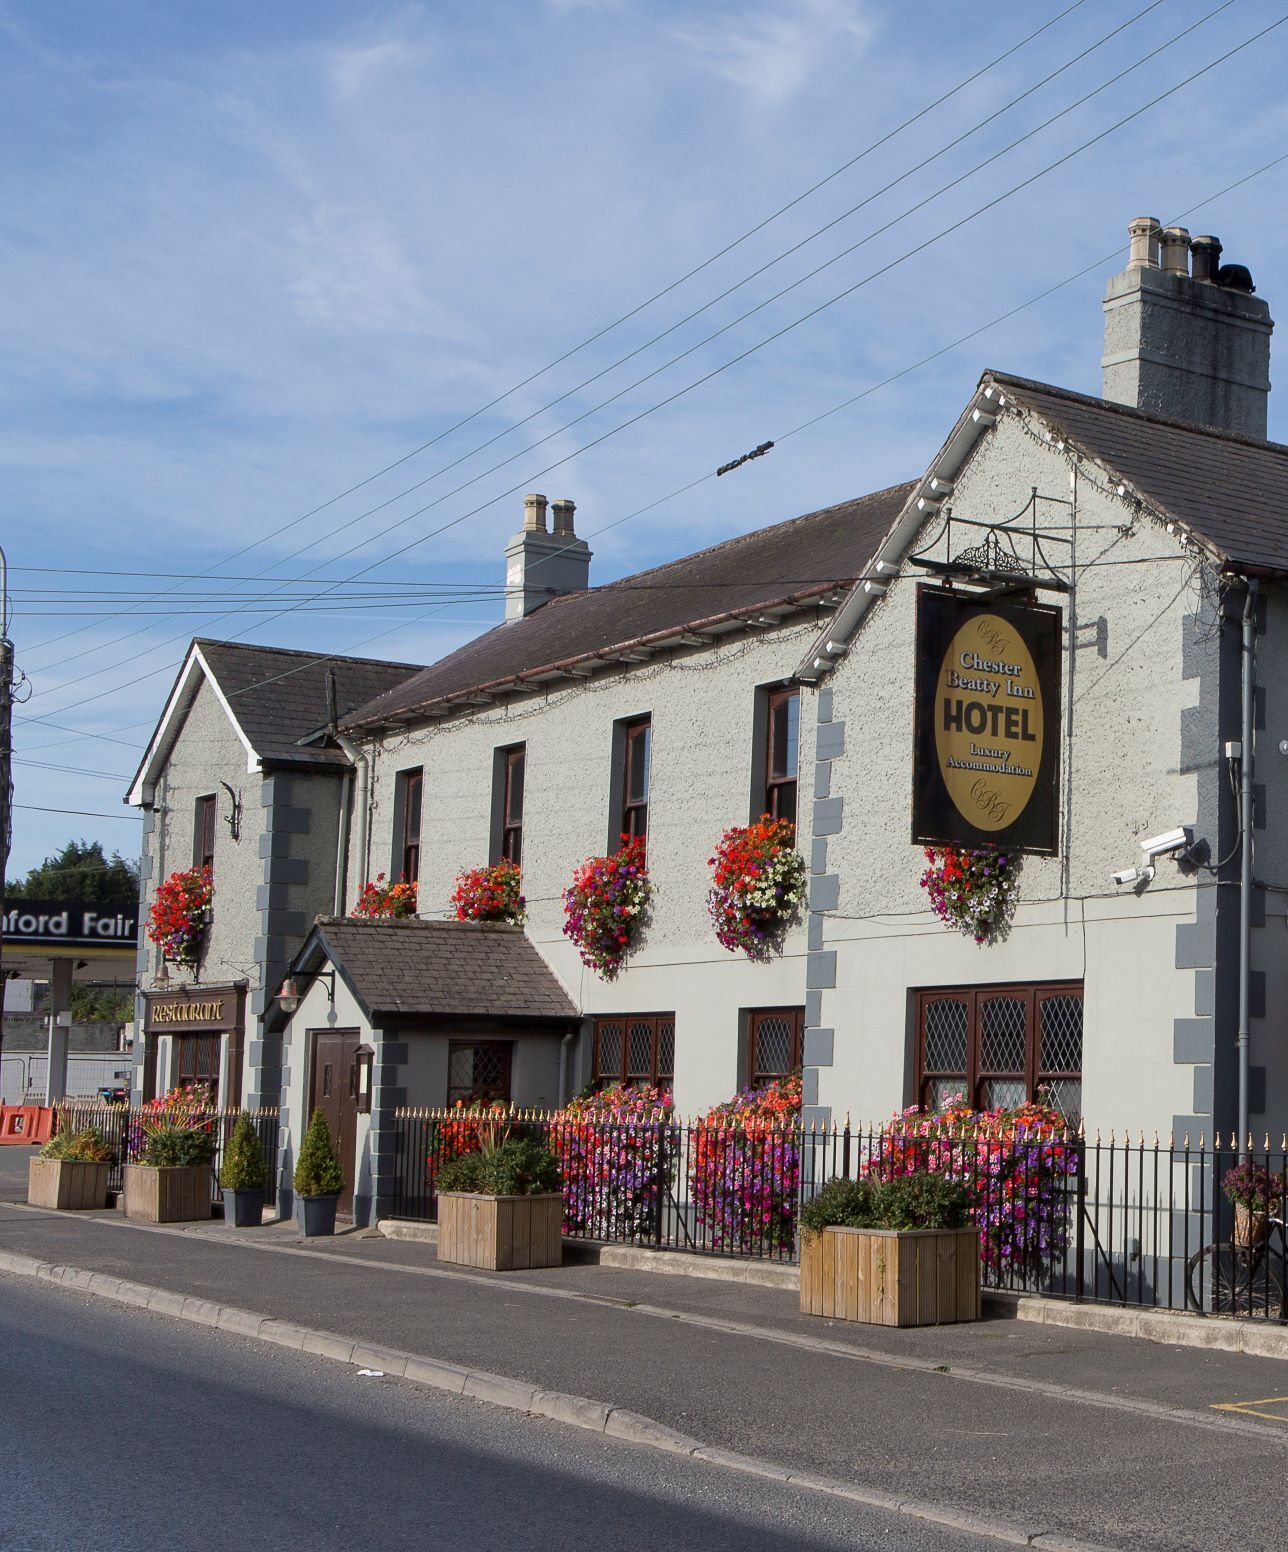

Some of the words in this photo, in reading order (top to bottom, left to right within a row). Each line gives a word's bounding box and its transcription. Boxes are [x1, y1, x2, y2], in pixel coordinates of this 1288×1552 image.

[959, 651, 1022, 677] Chester
[946, 669, 999, 698] Beatty
[1006, 678, 1035, 699] Inn
[943, 698, 1036, 742] HOTEL
[969, 742, 1011, 761] Luxury
[946, 756, 1033, 777] Accommodation
[83, 911, 134, 936] Fair
